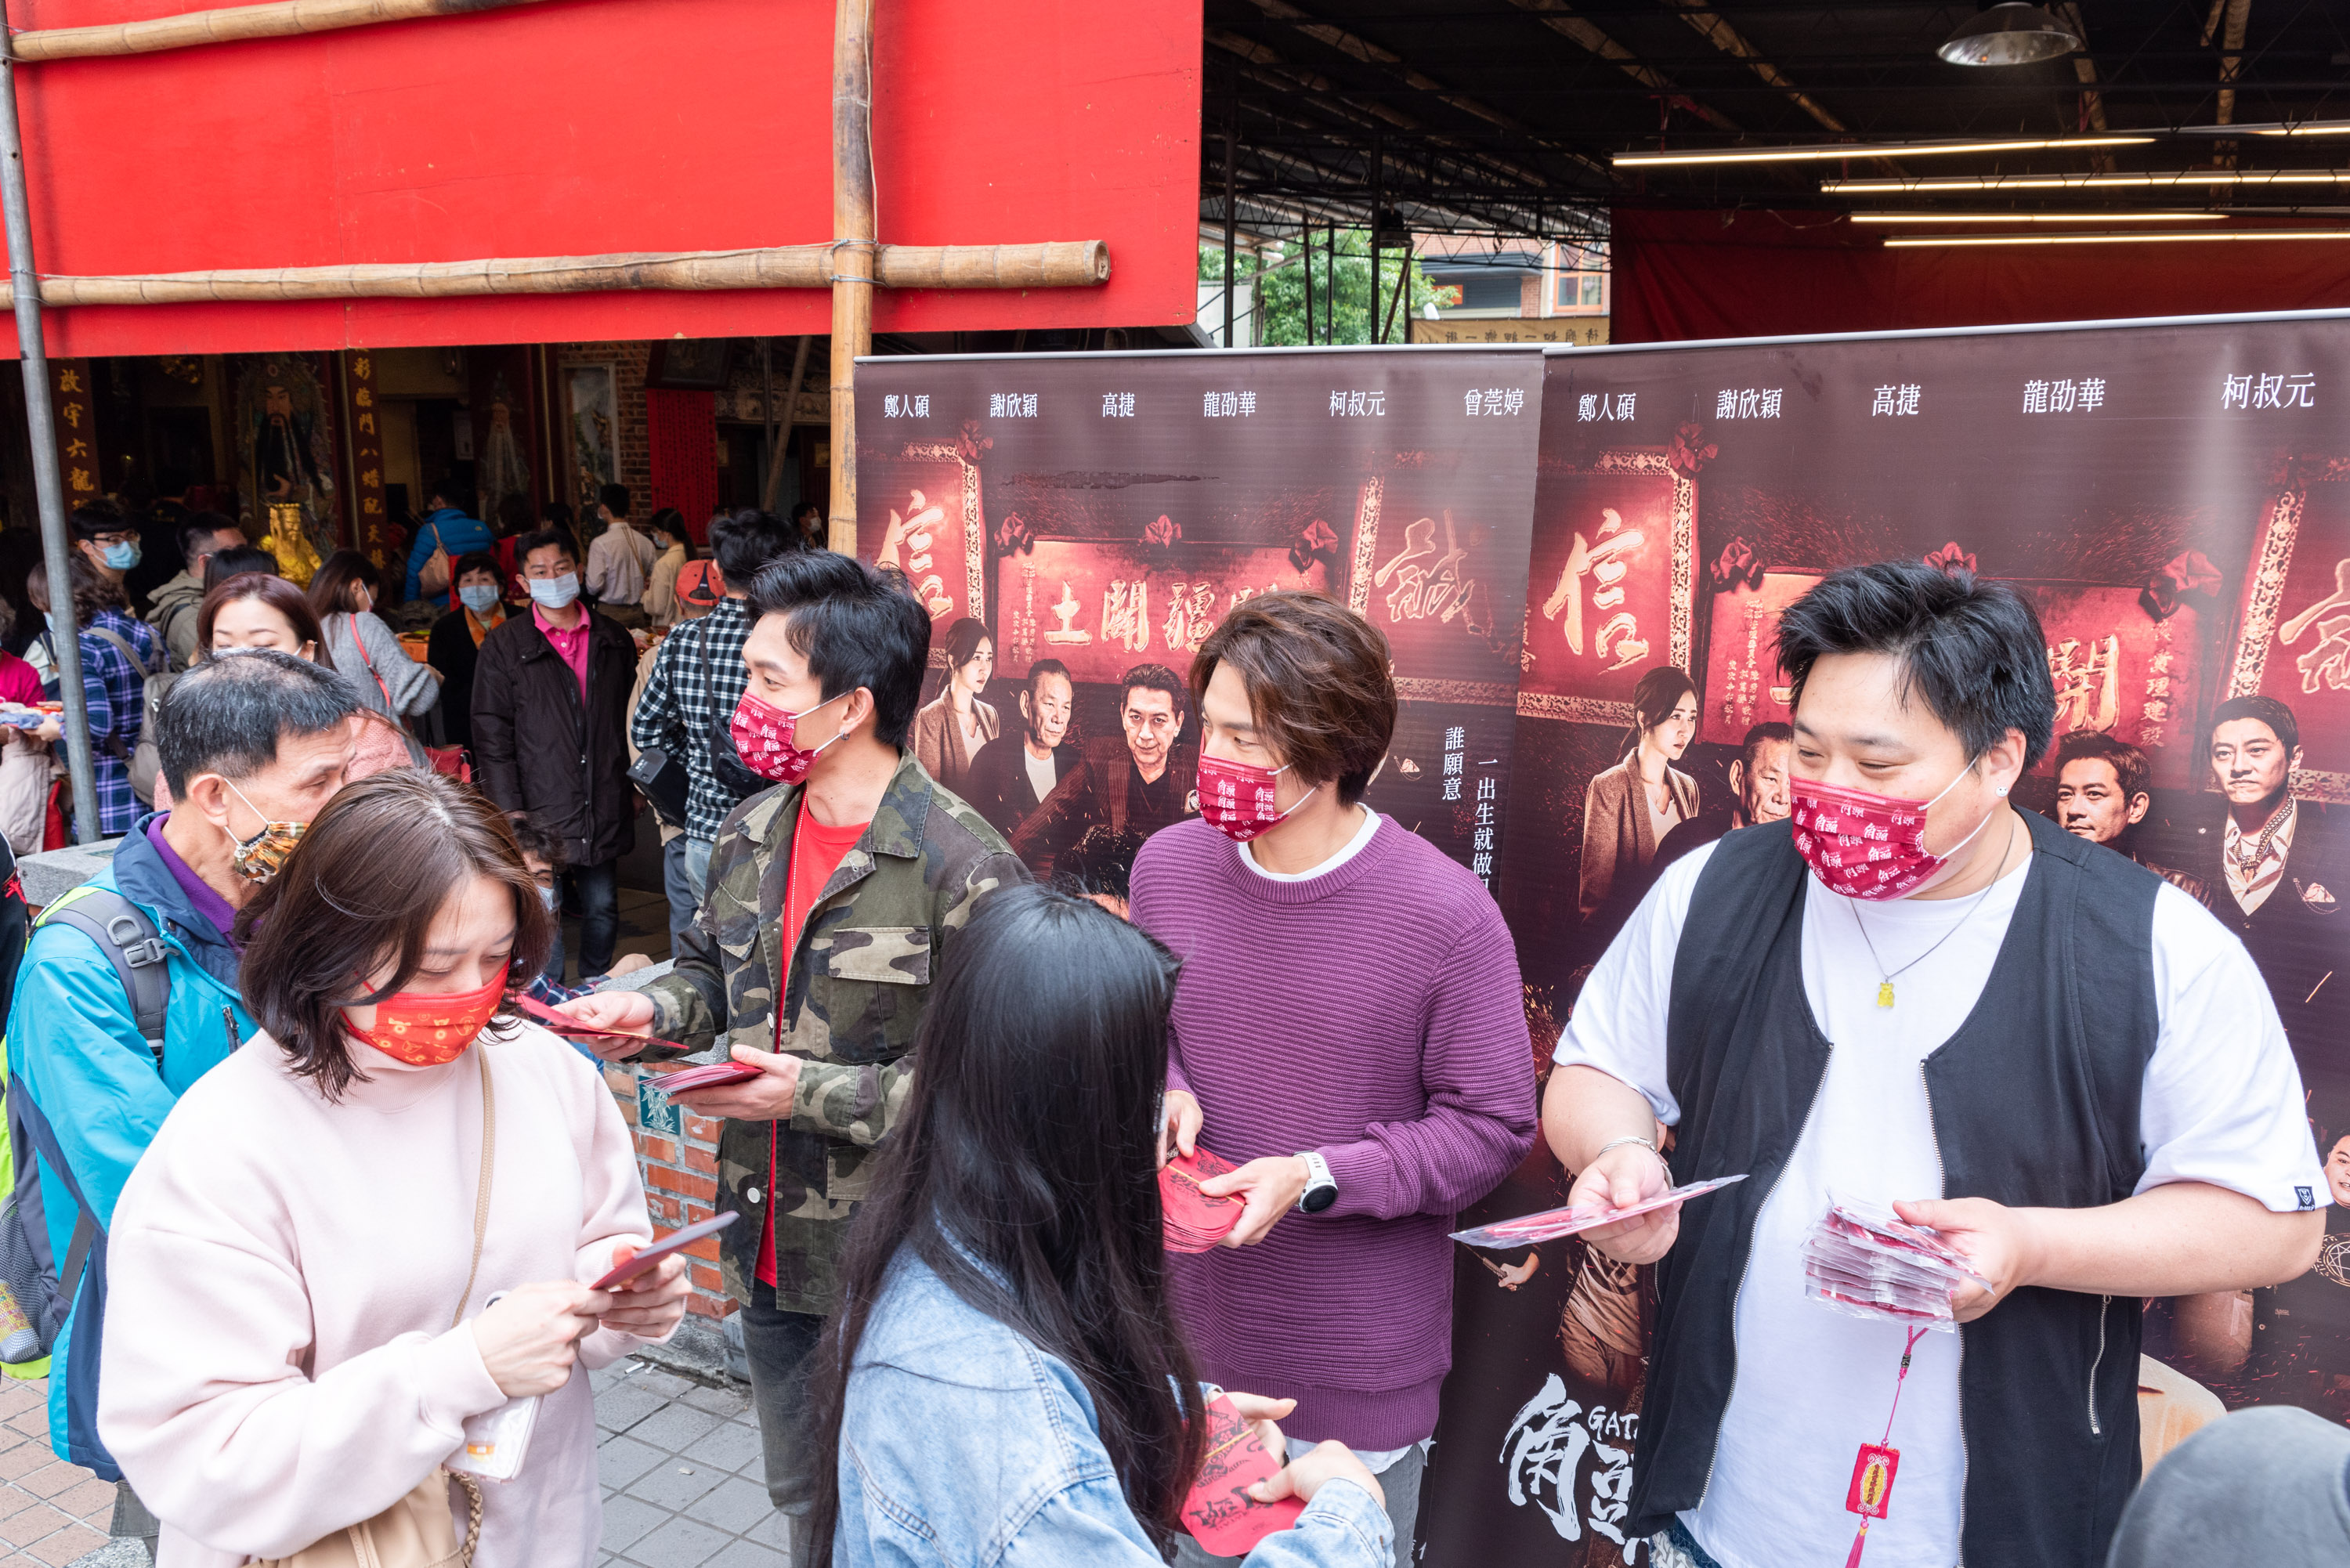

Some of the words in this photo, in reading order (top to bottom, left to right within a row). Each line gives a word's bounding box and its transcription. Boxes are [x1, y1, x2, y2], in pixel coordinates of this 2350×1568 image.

[884, 394, 930, 418] 鄭人碩
[989, 392, 1038, 418] 謝欣穎
[1102, 392, 1135, 417] 高捷
[1203, 390, 1256, 417] 龍劭華
[1329, 389, 1386, 417] 柯叔元
[1463, 388, 1524, 417] 曾莞婷
[1577, 392, 1636, 422] 鄭人碩
[1716, 388, 1783, 420] 謝欣穎
[1872, 383, 1922, 417] 高捷
[2023, 377, 2106, 414] 龍劭華
[2220, 372, 2316, 410] 柯叔元
[1542, 508, 1650, 676] 信
[1442, 726, 1466, 801] 誰願意
[1472, 758, 1499, 890] 一出生就做
[1814, 813, 1839, 834] 角頭
[1864, 822, 1889, 842] 角頭
[1588, 1405, 1641, 1441] GAT
